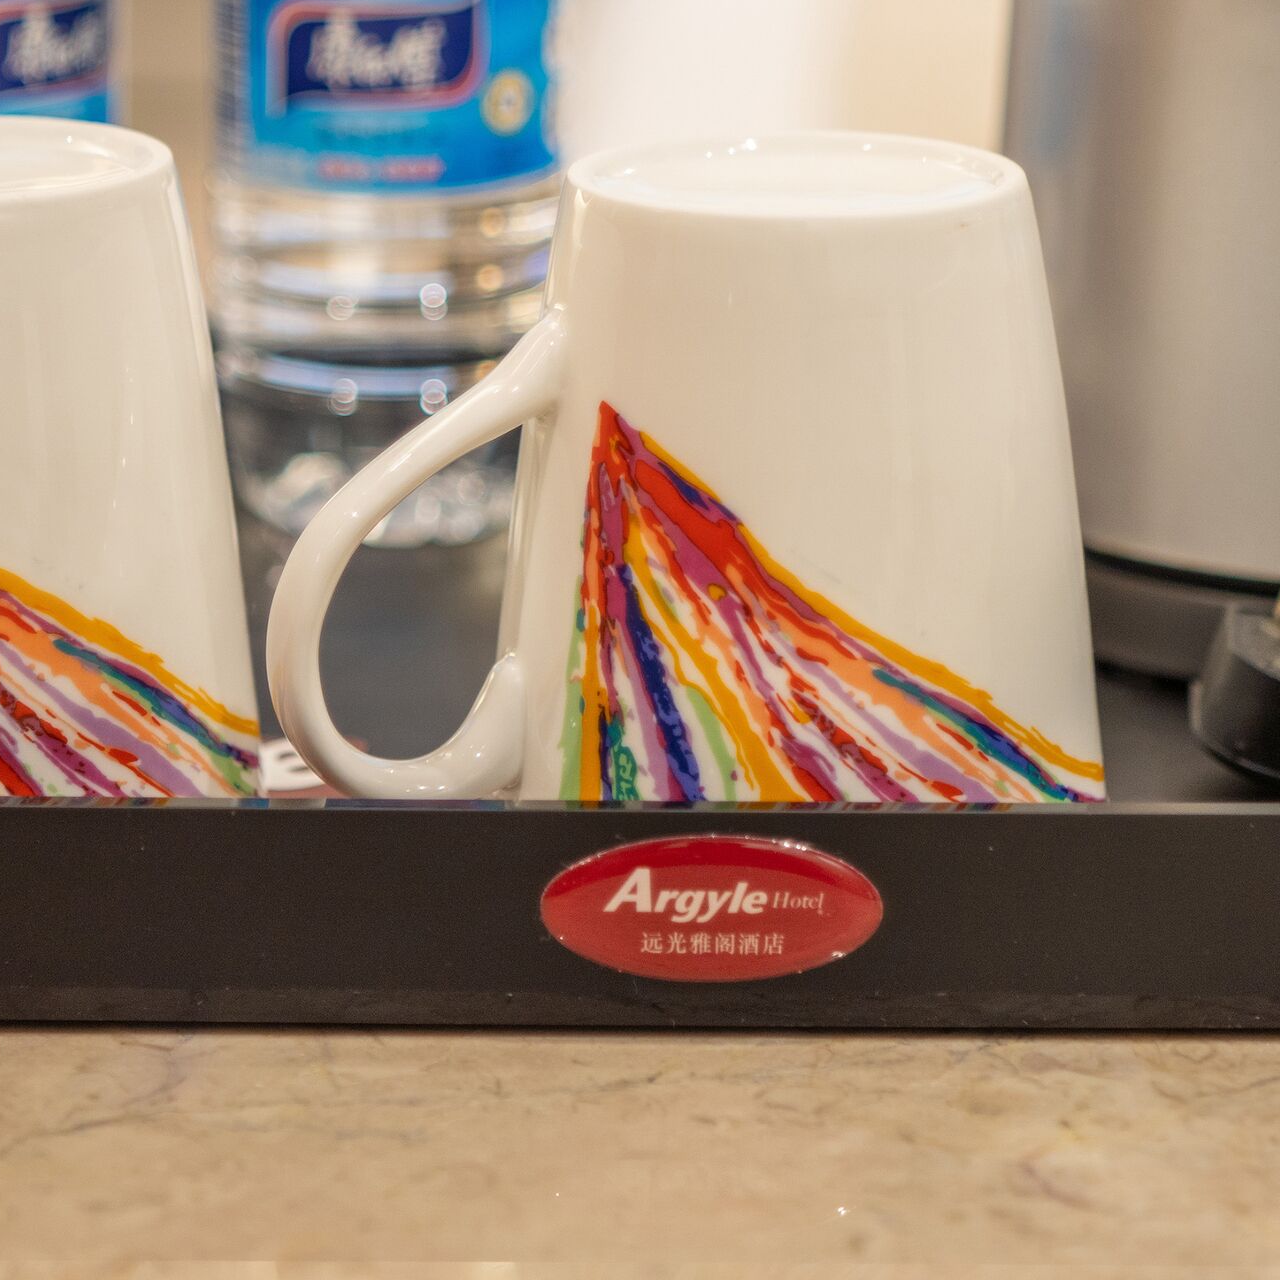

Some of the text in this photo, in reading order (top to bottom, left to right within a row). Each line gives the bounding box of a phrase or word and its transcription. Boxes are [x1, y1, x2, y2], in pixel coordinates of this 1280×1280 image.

[603, 866, 825, 923] Argyle Hotel
[640, 932, 786, 955] 远光雅阁酒店
